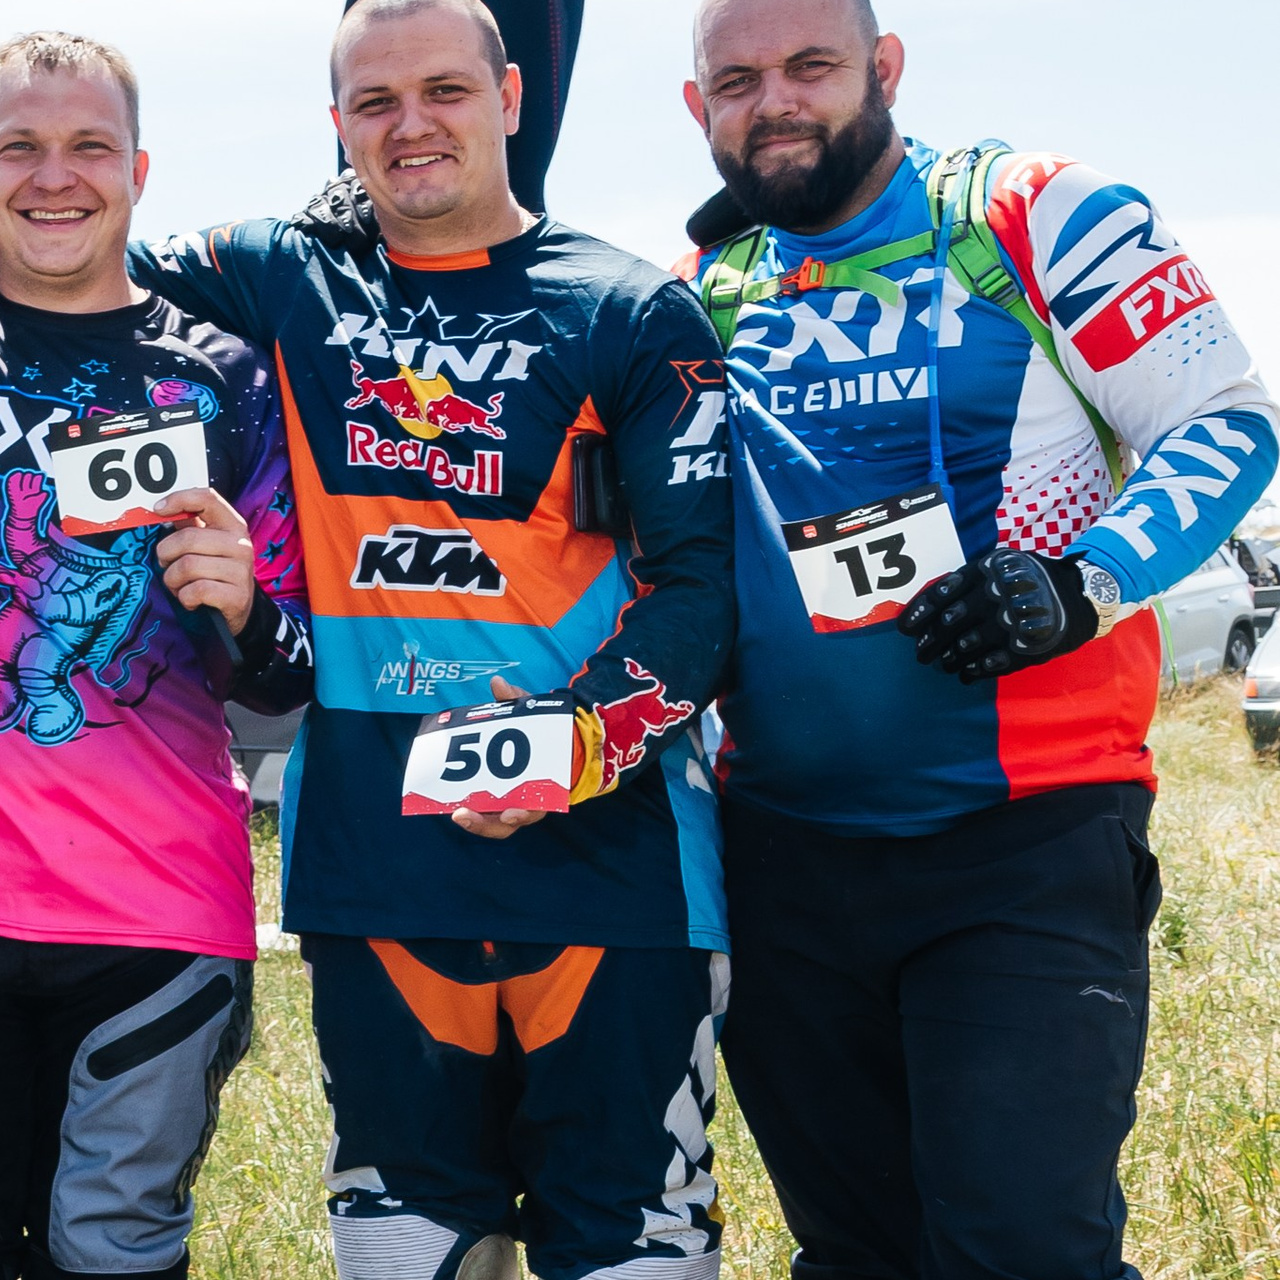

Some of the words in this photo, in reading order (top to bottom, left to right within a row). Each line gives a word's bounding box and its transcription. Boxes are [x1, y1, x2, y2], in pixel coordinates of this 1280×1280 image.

[1119, 259, 1211, 341] FXR
[88, 441, 178, 502] 60
[346, 420, 426, 471] Red
[424, 445, 504, 497] Bull
[350, 524, 508, 597] KTM
[833, 532, 917, 598] 13
[387, 662, 462, 679] WINGS
[395, 678, 437, 696] LIFE
[439, 727, 532, 783] 50
